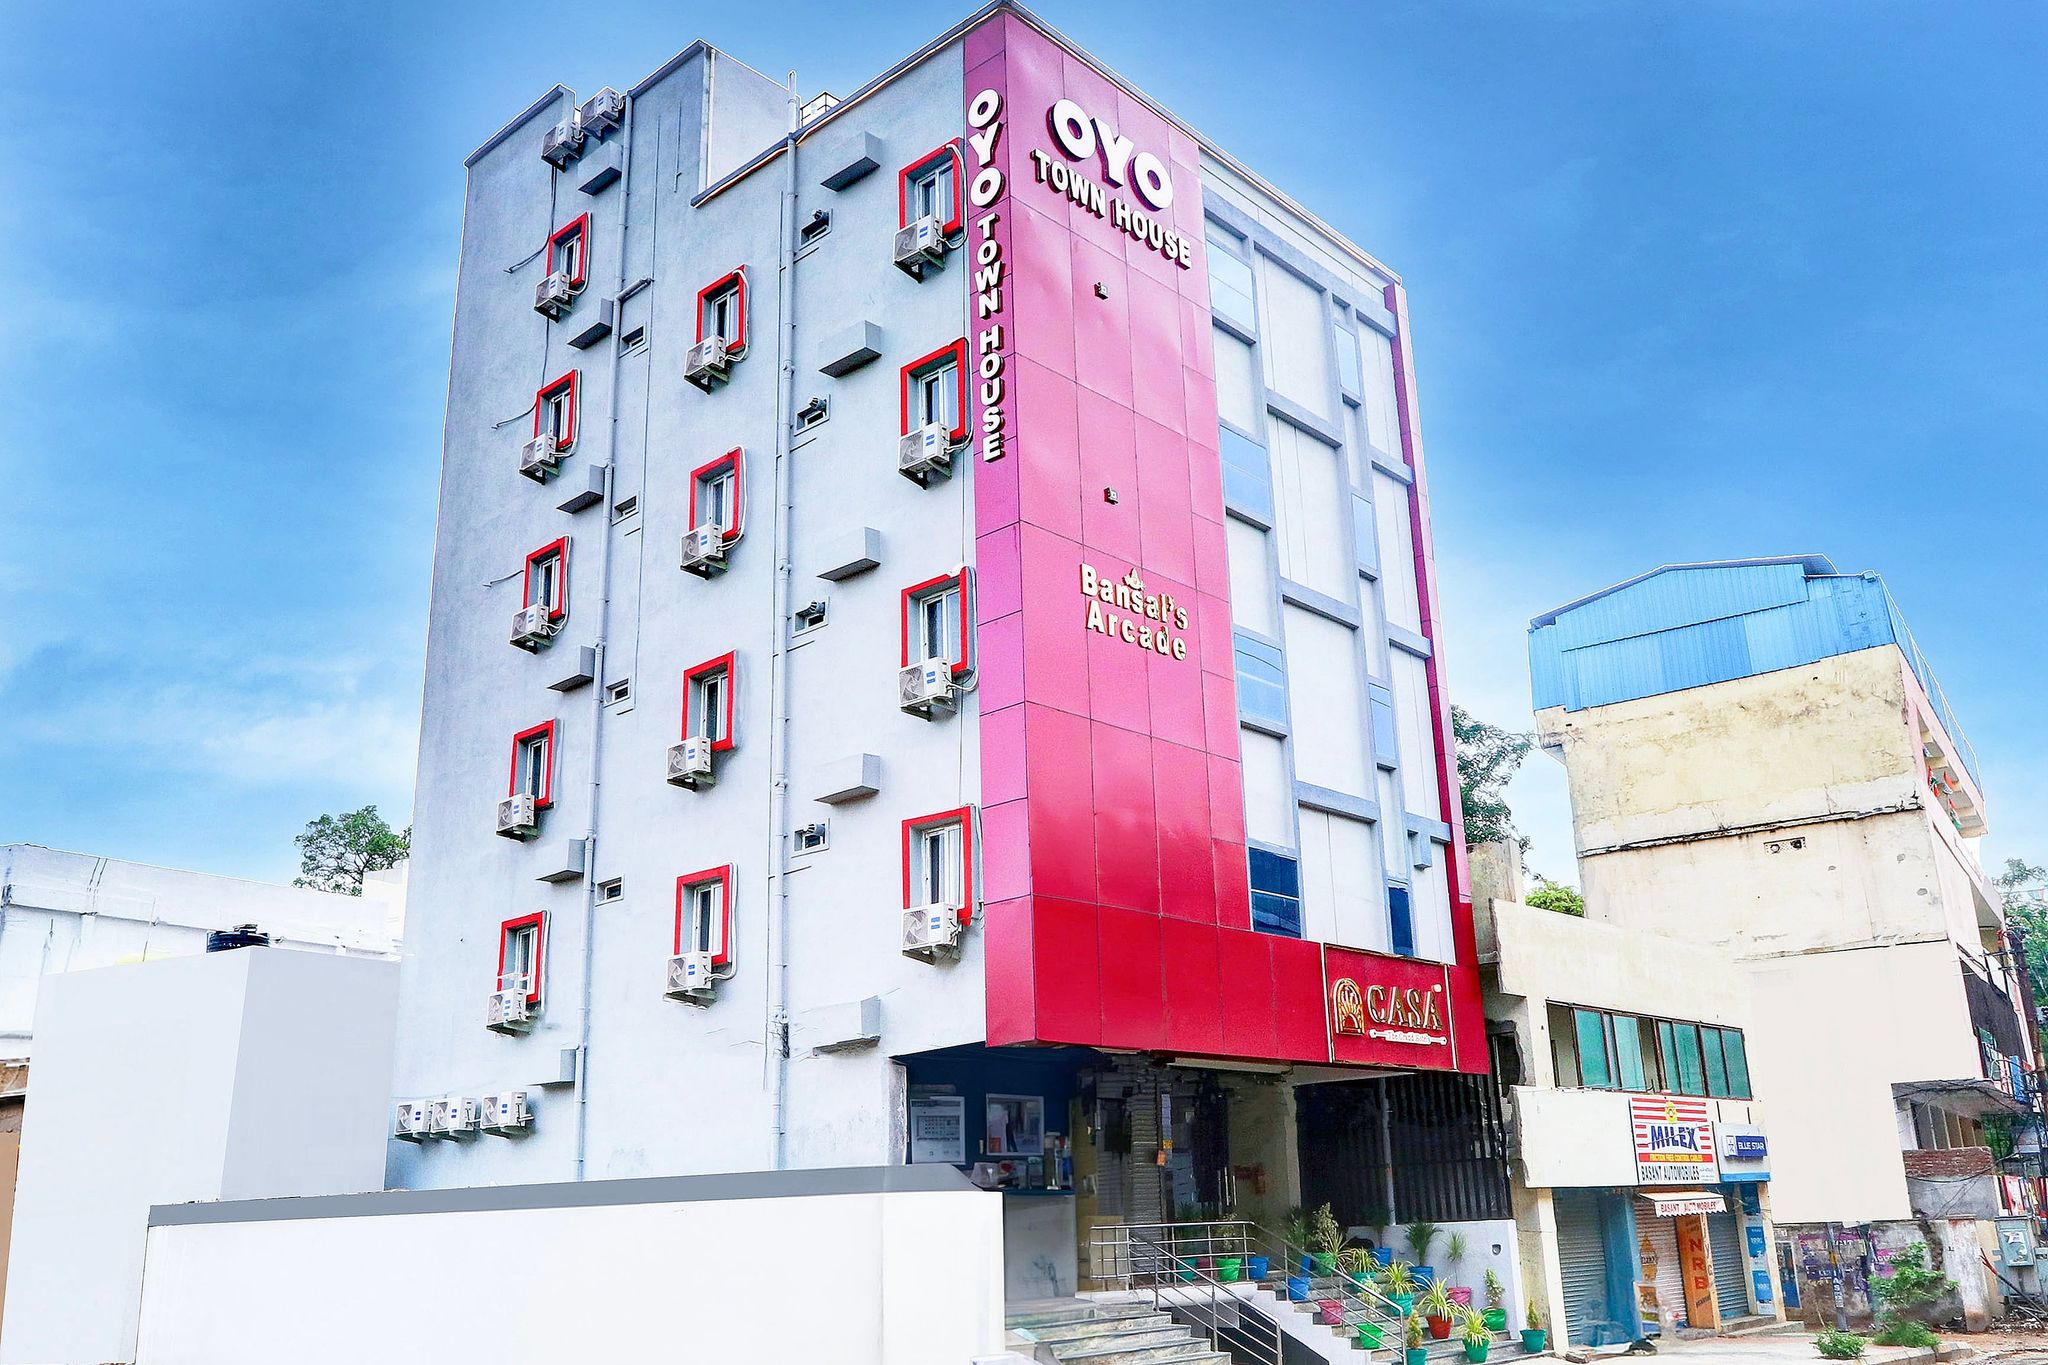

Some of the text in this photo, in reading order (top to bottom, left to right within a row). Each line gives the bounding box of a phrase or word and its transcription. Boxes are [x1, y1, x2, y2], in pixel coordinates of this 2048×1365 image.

[1047, 98, 1174, 211] OYO
[1031, 148, 1192, 270] TOWN HOUSE
[968, 88, 1005, 463] OYO TOWN HOUSE
[1081, 562, 1189, 630] Bansal's
[1086, 599, 1187, 661] Arcade
[1367, 984, 1443, 1030] CASA
[1651, 1125, 1699, 1152] MILEX
[1738, 1141, 1765, 1150] BLUE STAR
[1641, 1165, 1662, 1181] BASANT
[1660, 1203, 1680, 1213] BASANT
